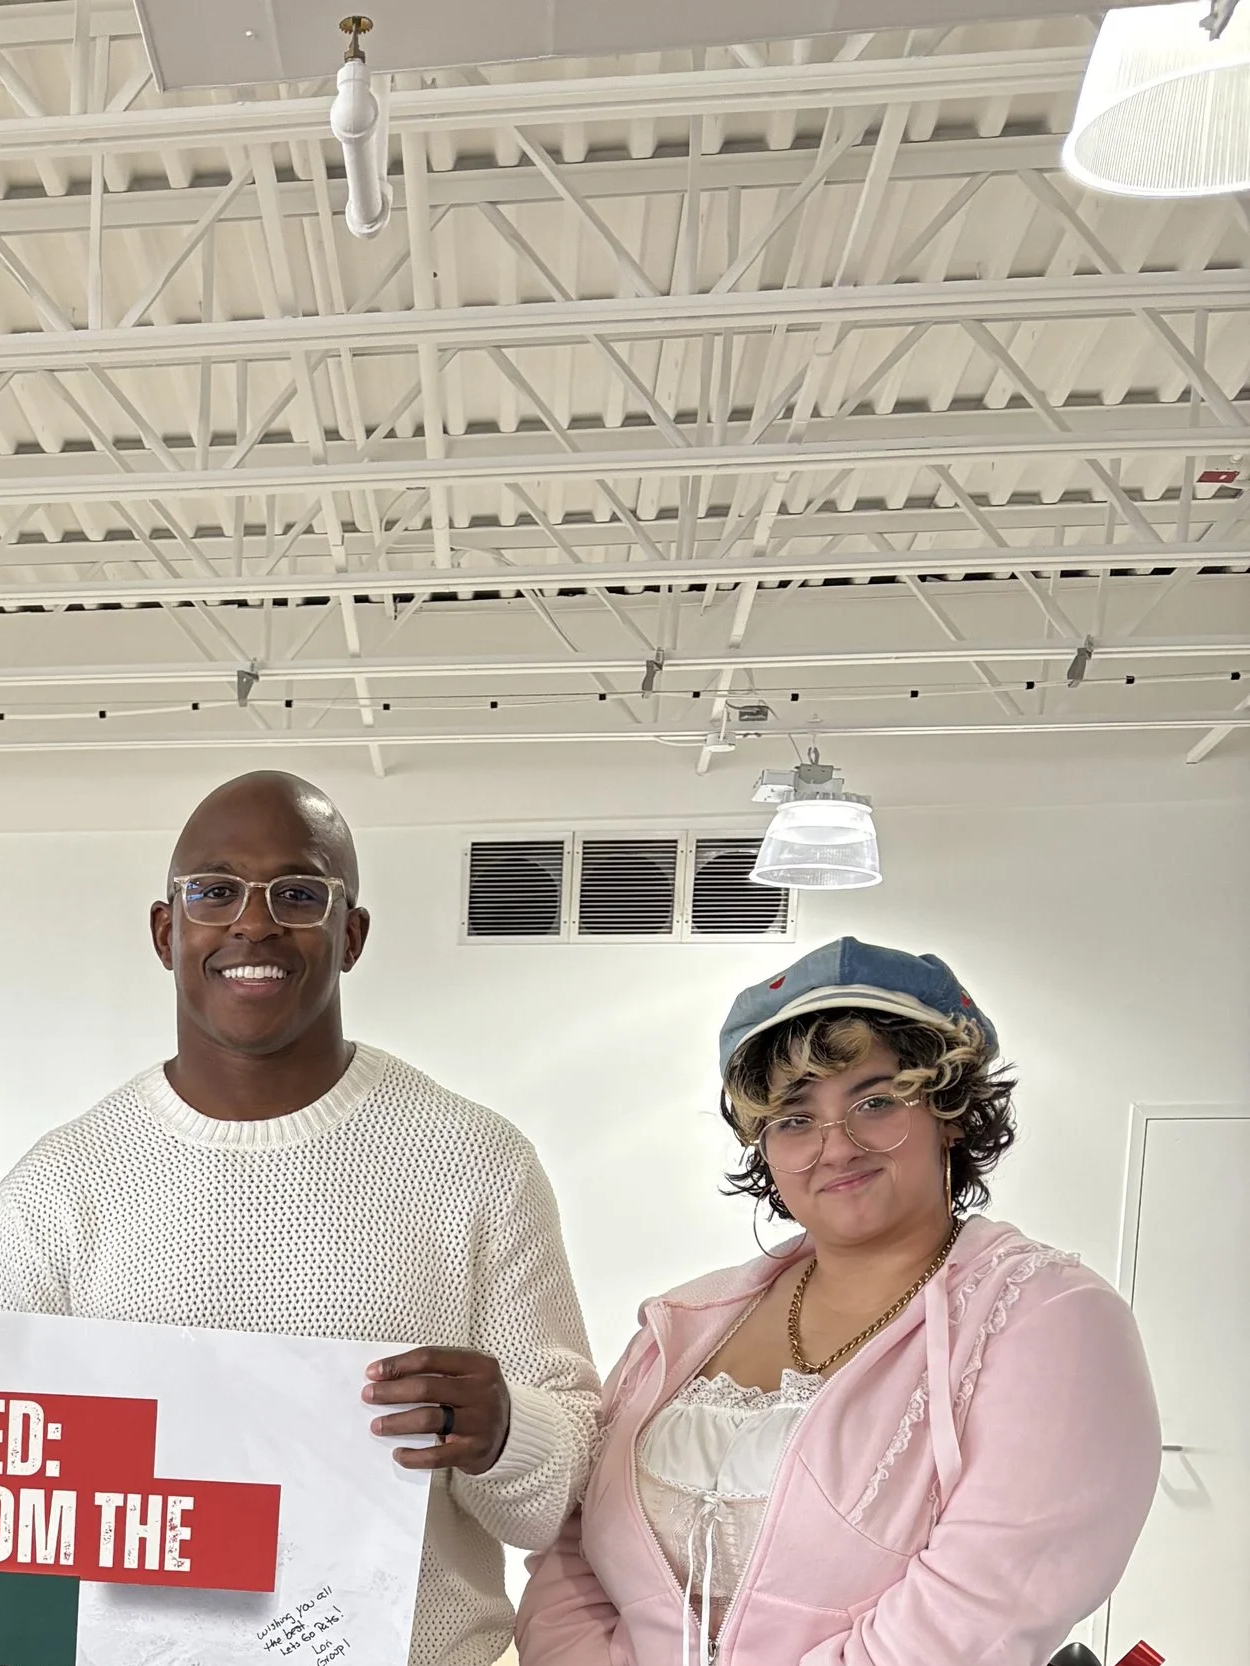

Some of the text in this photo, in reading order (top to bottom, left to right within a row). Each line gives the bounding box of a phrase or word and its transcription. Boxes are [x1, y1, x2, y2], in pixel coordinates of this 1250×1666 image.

[94, 1492, 195, 1572] THE
[296, 1600, 315, 1618] you
[317, 1586, 332, 1600] all
[264, 1637, 282, 1651] the
